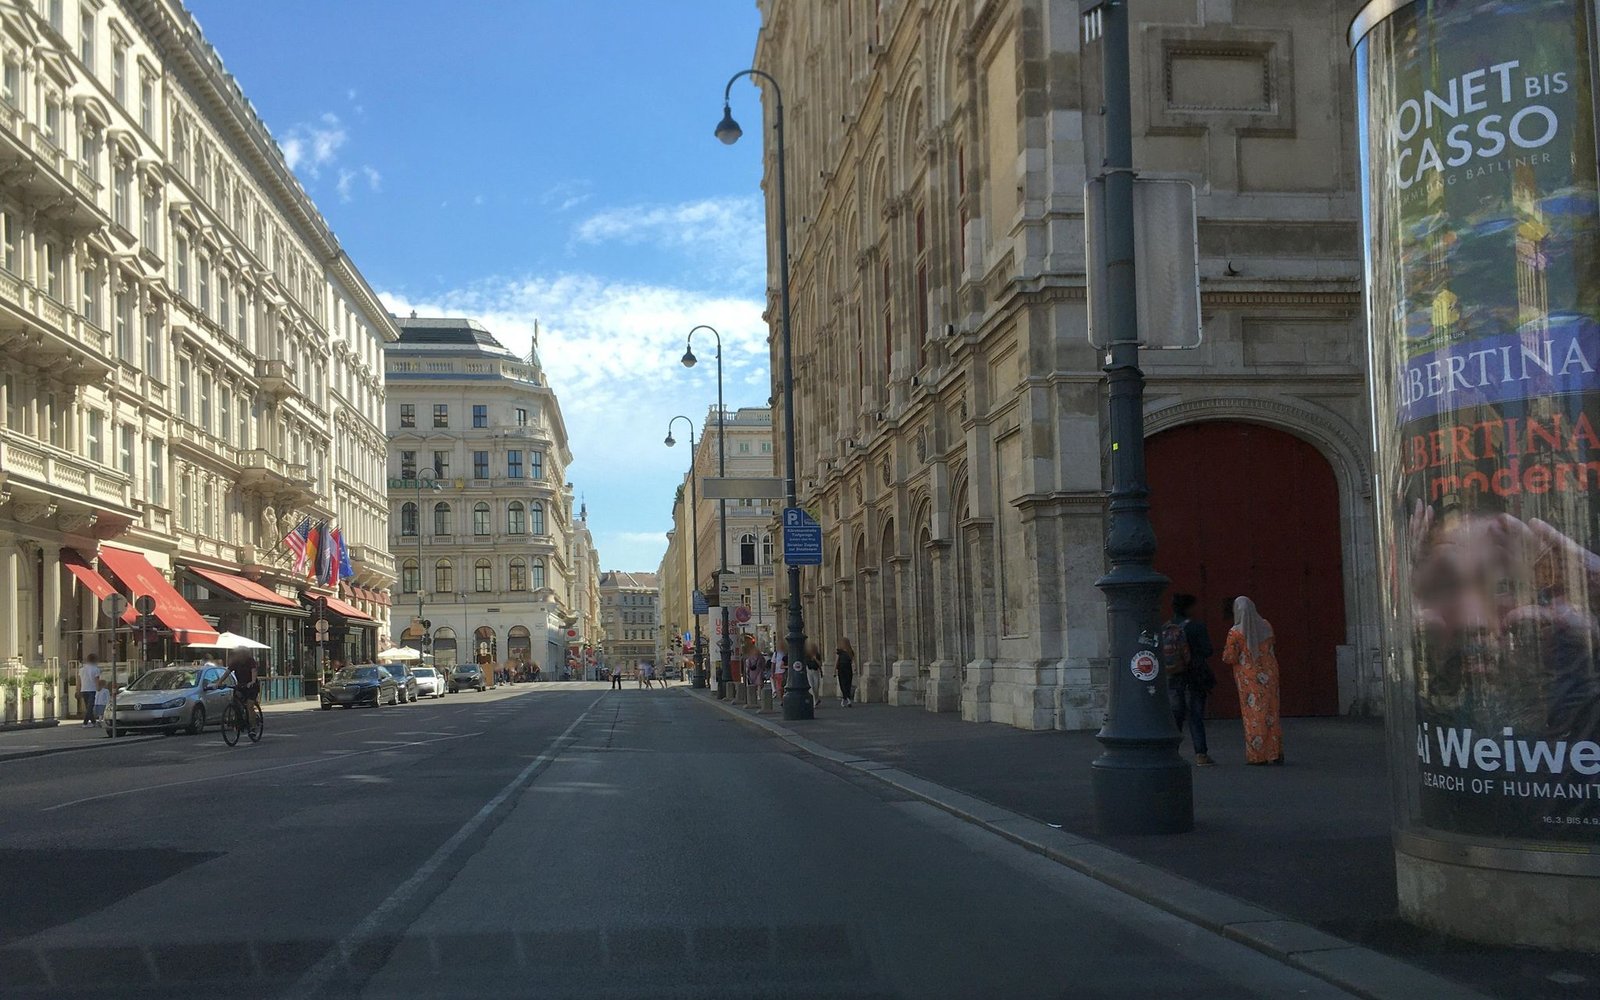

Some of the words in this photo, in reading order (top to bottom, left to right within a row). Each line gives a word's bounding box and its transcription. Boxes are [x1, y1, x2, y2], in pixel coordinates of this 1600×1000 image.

[1394, 60, 1520, 142] ONET
[1525, 72, 1569, 98] BIS
[1394, 105, 1558, 190] CASSO
[1466, 152, 1551, 180] BATLINER
[1436, 726, 1600, 775] Weiwe
[1424, 771, 1465, 792] SEARCH
[1471, 778, 1494, 795] OF
[1566, 816, 1581, 825] BIS
